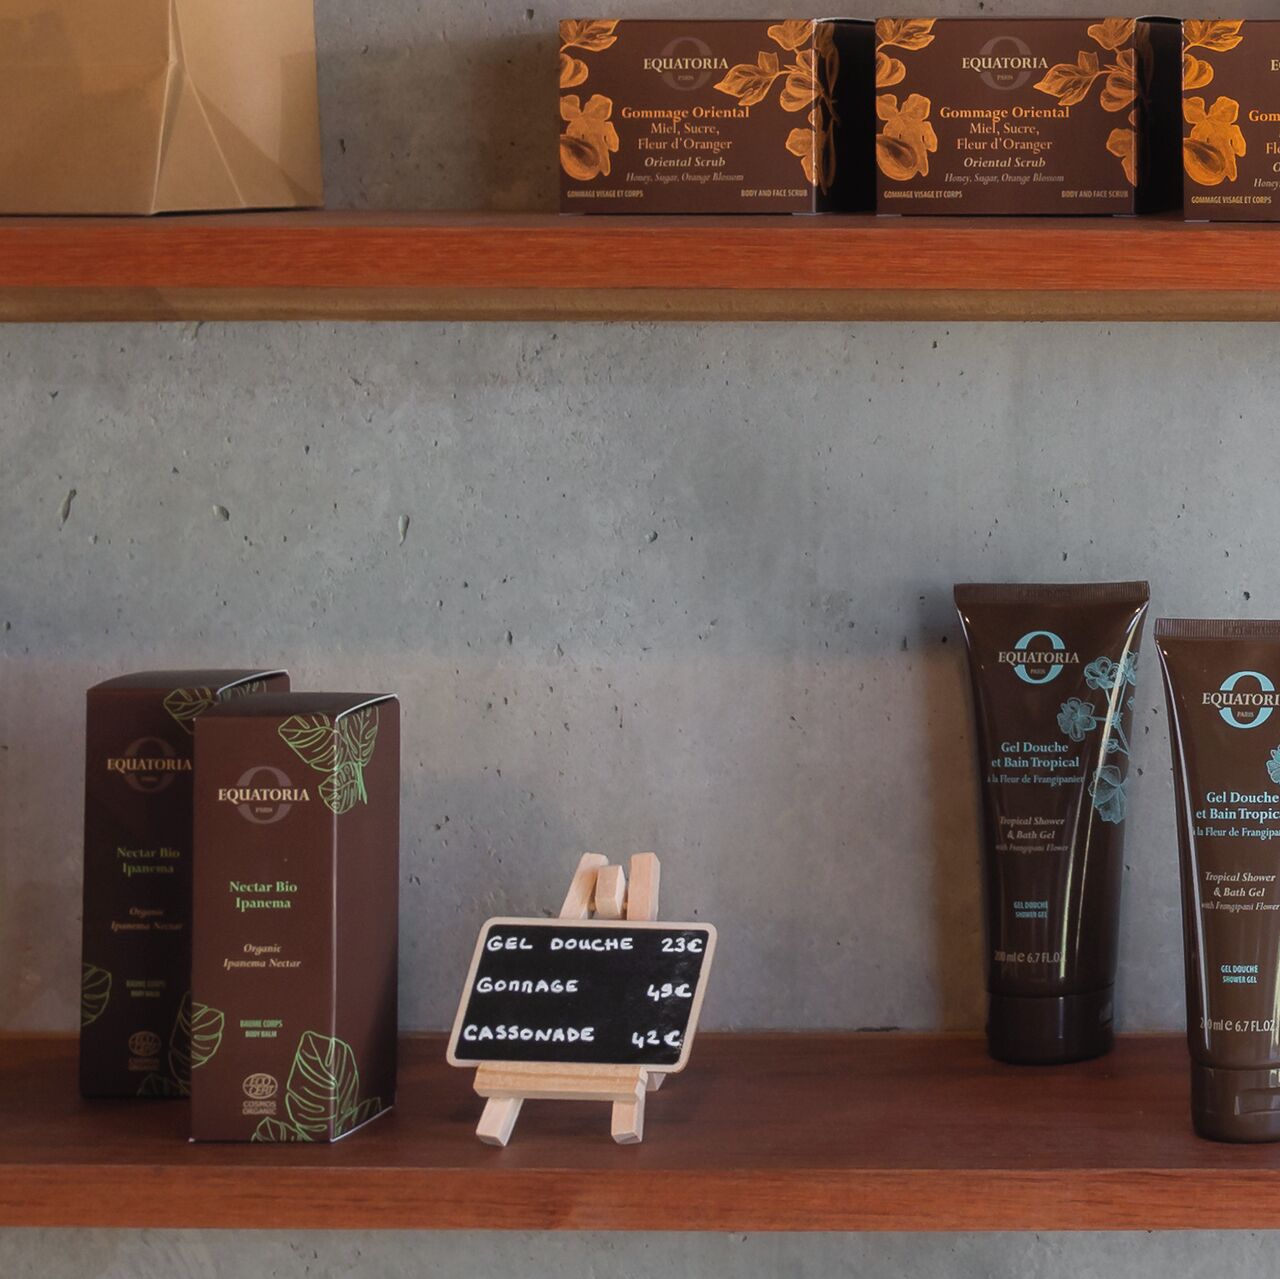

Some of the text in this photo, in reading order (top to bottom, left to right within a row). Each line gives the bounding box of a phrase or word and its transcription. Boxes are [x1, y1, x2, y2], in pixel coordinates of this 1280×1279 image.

[644, 58, 728, 73] EQUATORIA
[962, 57, 1048, 72] EQUATORIA
[622, 106, 749, 122] Gommage Oriental
[998, 652, 1080, 666] EQUATORIA
[107, 758, 192, 774] EQUATORIA
[218, 788, 310, 804] EQUATORIA
[1207, 792, 1279, 804] Gel Douche
[1196, 810, 1206, 819] et
[1210, 809, 1236, 819] Bain
[1205, 828, 1226, 836] Fleur
[1229, 828, 1239, 836] de
[1205, 872, 1276, 882] Tropical Shower
[229, 881, 297, 893] Nectar Bio
[1214, 888, 1265, 896] & Bath Gel
[236, 898, 291, 912] Ipanema
[244, 944, 282, 956] Organic
[487, 936, 702, 952] GEL DOUCHE 23€
[224, 958, 301, 970] Ipanema Nectar
[1221, 965, 1258, 973] GEL DOUCHE
[647, 983, 692, 1001] 49€
[463, 1024, 595, 1042] CASSONADE
